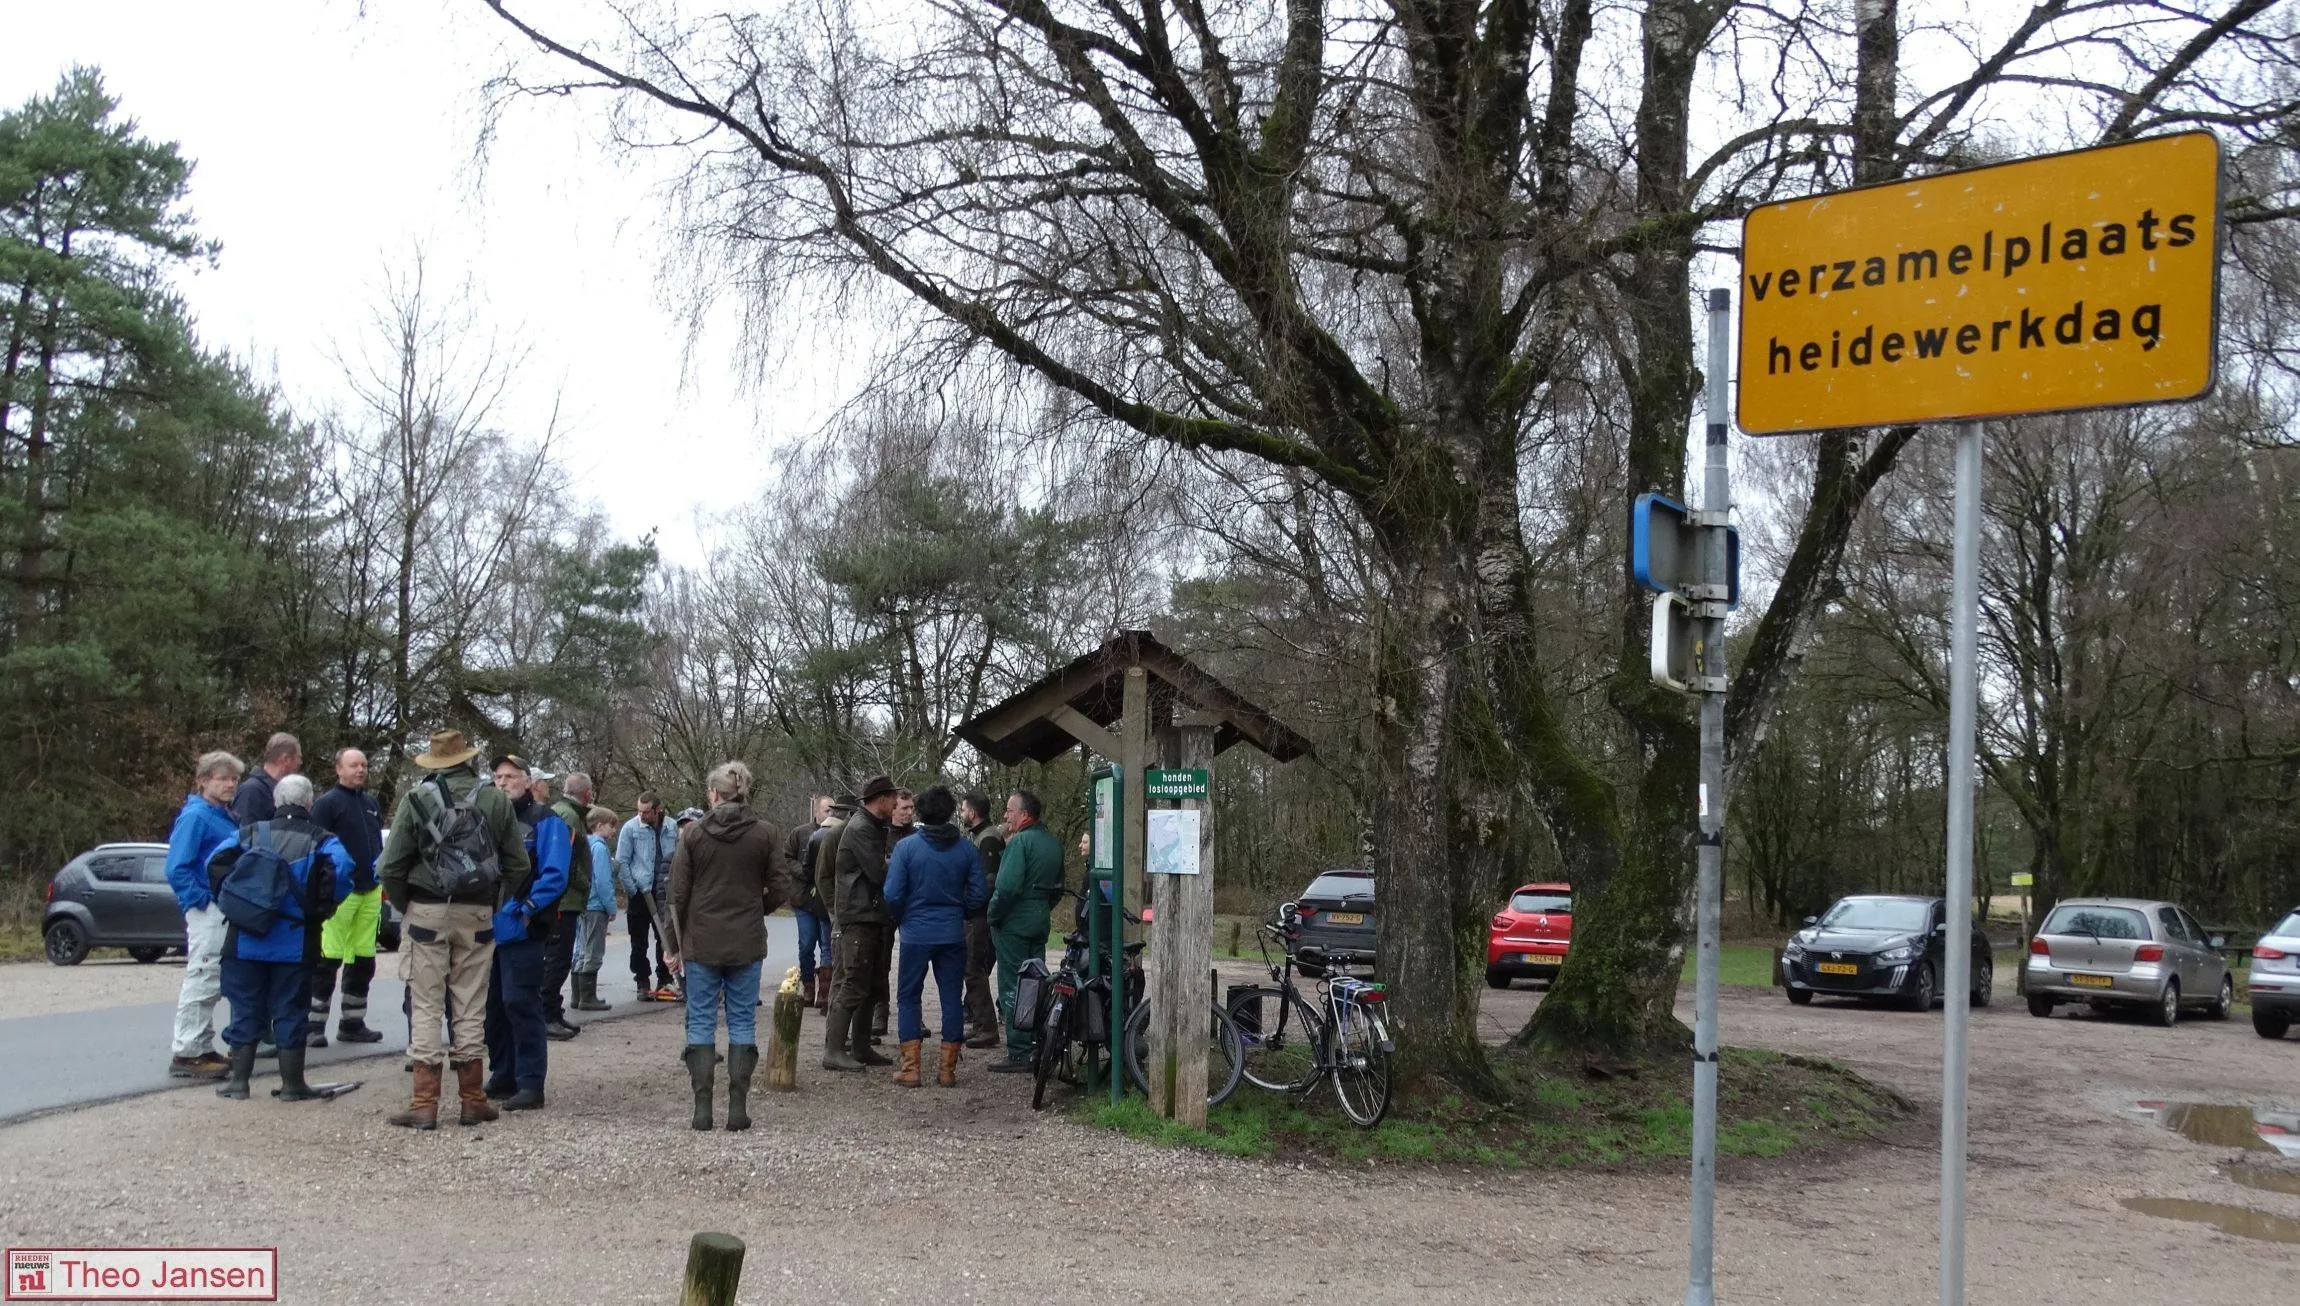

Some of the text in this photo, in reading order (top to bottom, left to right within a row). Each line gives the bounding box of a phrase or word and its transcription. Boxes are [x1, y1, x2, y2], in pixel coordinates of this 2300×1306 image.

[1749, 209, 2196, 301] verzamelplaats
[1768, 301, 2162, 375] heidewerkdag
[1149, 784, 1205, 796] losloopgebied
[1162, 773, 1192, 782] honden
